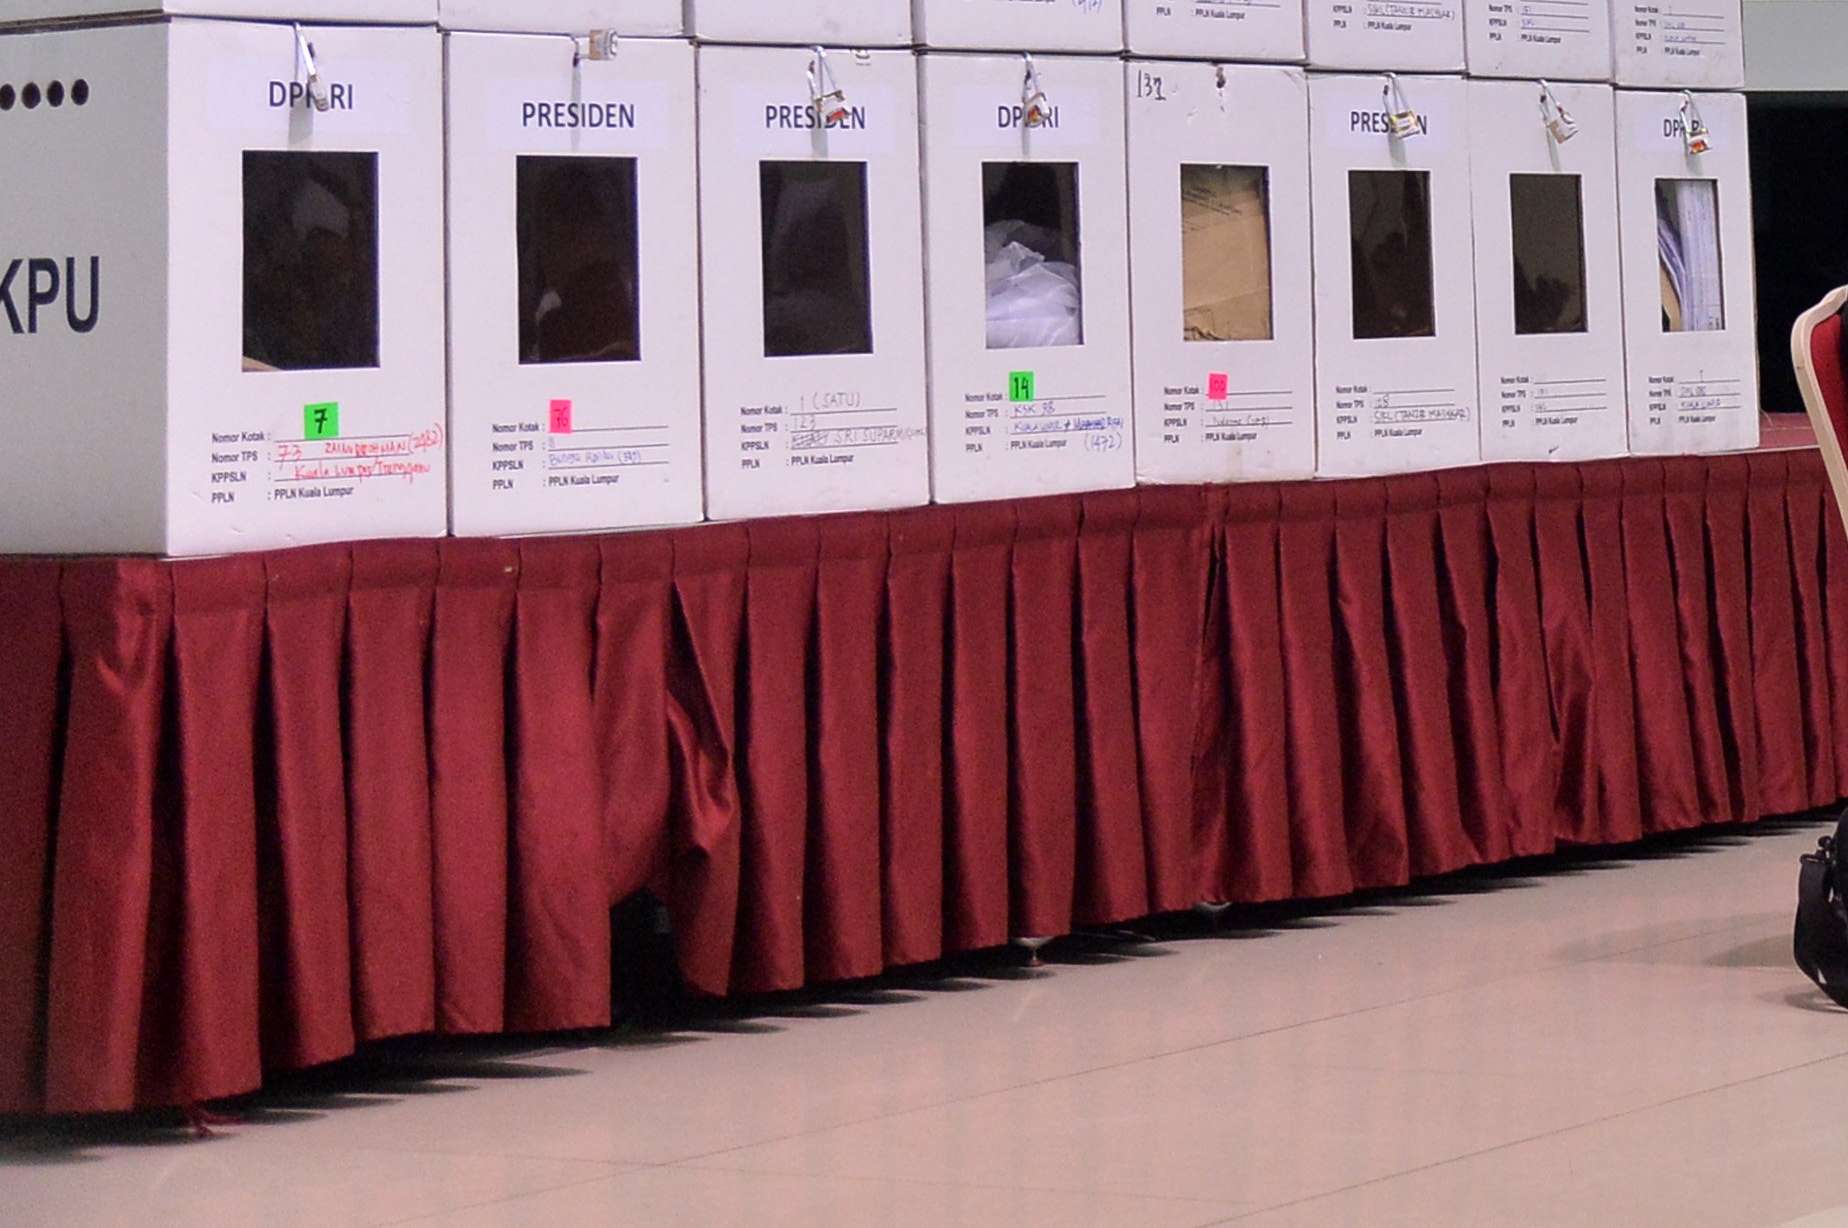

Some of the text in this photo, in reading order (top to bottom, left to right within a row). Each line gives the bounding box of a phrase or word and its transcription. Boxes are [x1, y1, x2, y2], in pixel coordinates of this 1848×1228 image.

[330, 83, 354, 110] RI
[522, 103, 635, 128] PRESIDEN
[998, 105, 1036, 128] DP
[1350, 111, 1428, 135] PRESN
[0, 256, 100, 334] KPU
[1014, 377, 1029, 400] 14
[314, 409, 327, 434] 7
[493, 422, 539, 433] Nomor Kotak
[212, 432, 264, 443] Nomor Kotak
[493, 440, 533, 452] Nomor TPS
[212, 451, 258, 463] Nomor TPS
[212, 471, 246, 483] KPPSLN
[549, 474, 619, 487] PPLN Kuala Lumpur
[493, 479, 513, 490] PPLN
[212, 492, 235, 503] PPLN
[274, 486, 354, 501] PPLN Kuala Lumpur
